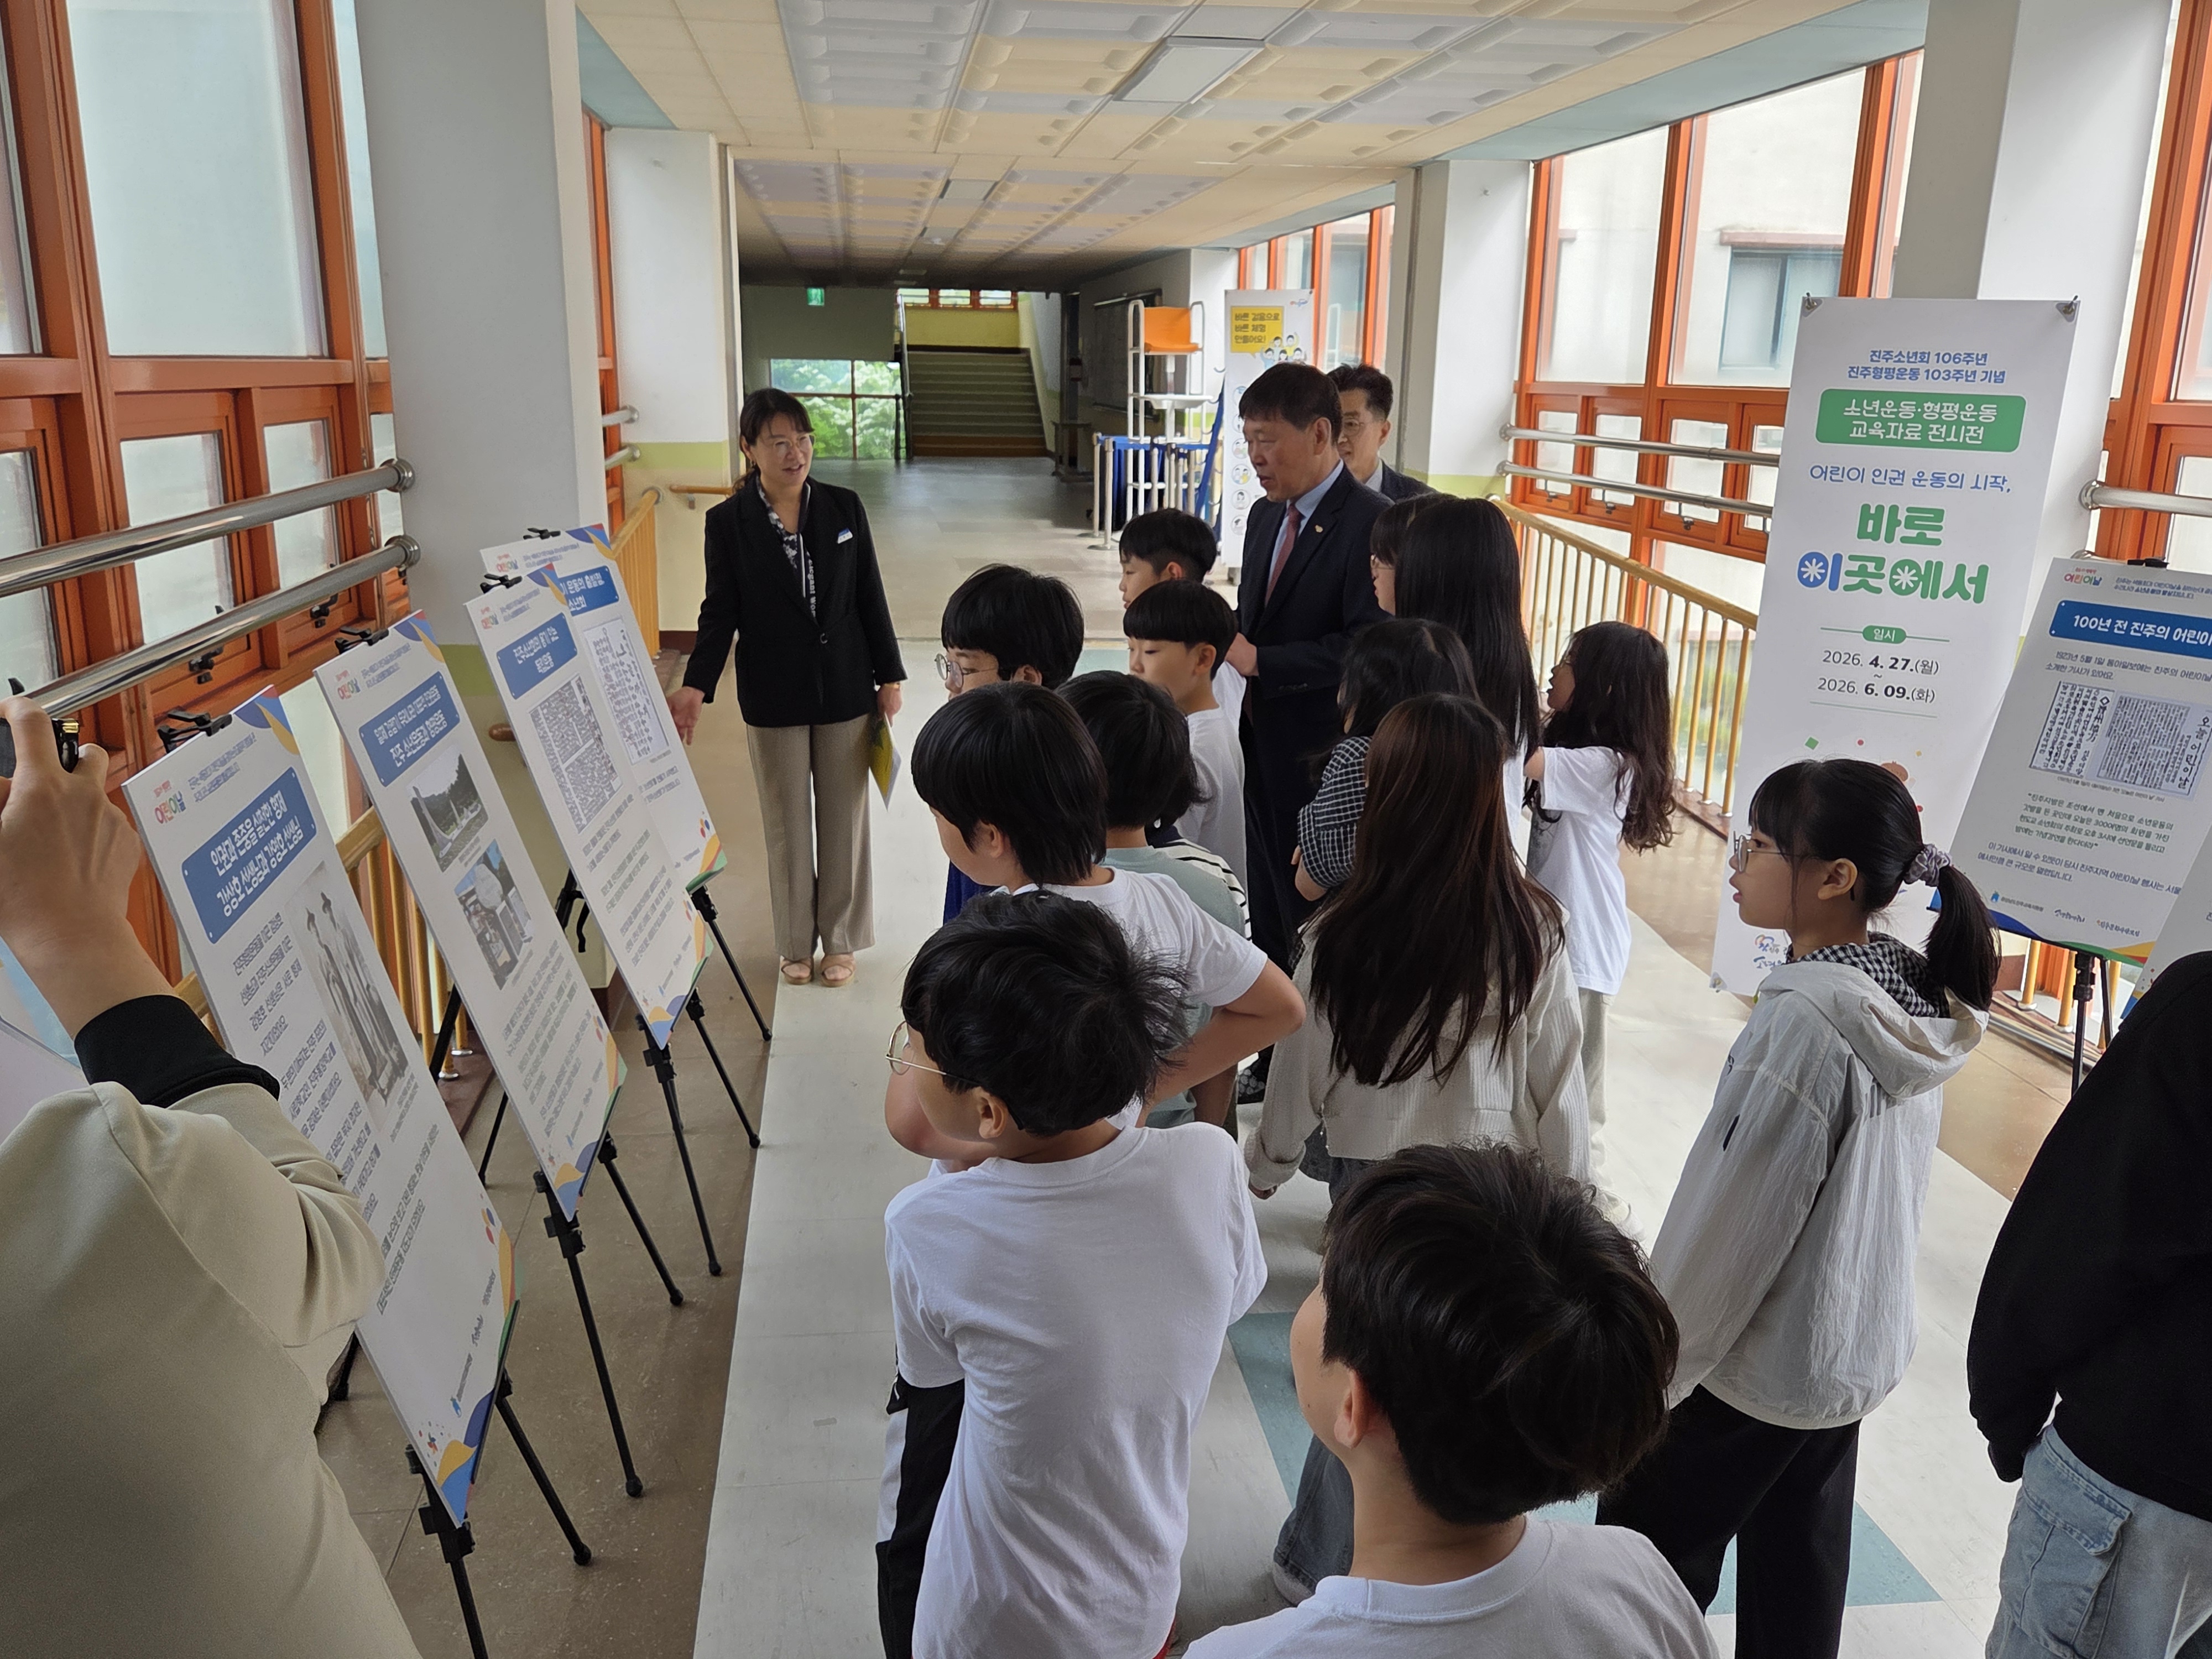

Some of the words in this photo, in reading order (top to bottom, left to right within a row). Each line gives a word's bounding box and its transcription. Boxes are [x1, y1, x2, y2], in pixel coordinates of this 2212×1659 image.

[1869, 349, 1931, 364] 진주소년회
[1935, 352, 1988, 366] 106주년
[1848, 366, 1920, 382] 진주형평운동
[1924, 368, 1978, 383] 103주년
[1980, 370, 2006, 384] 기념
[1843, 399, 1998, 423] 소년운동·형평운동
[1849, 421, 1922, 441] 교육자료
[1928, 424, 1985, 445] 전시전
[1809, 465, 1865, 484] 어린이
[1871, 468, 1906, 487] 인권
[1911, 471, 1964, 489] 운동의
[1970, 474, 2011, 493] 시작,
[1857, 504, 1945, 546] 바로
[1797, 552, 1990, 604] 이곳에서
[2064, 572, 2103, 586] 어린이날
[1873, 628, 1897, 642] 일시
[2073, 614, 2112, 633] 100년
[2114, 619, 2128, 634] 전
[2130, 622, 2170, 640] 진주의
[2173, 627, 2212, 646] 어린이
[1822, 650, 1864, 667] 2026.
[1869, 655, 1884, 669] 4.
[1888, 656, 1939, 675] 27.(월)
[2068, 665, 2089, 676] 기사가
[2154, 666, 2178, 677] 진주의
[1818, 677, 1859, 695] 2026.
[1864, 682, 1879, 697] 6.
[1884, 684, 1936, 703] 09.(화)
[210, 837, 238, 876] 인권과
[232, 819, 258, 855] 존중을
[251, 802, 275, 838] 실천한
[269, 790, 288, 820] 형제
[217, 875, 245, 916] 강상호
[239, 850, 270, 894] 선생님과
[264, 832, 288, 869] 강영호
[281, 816, 304, 851] 선생님
[2079, 863, 2110, 878] 진주지역
[2110, 870, 2141, 885] 어린이날
